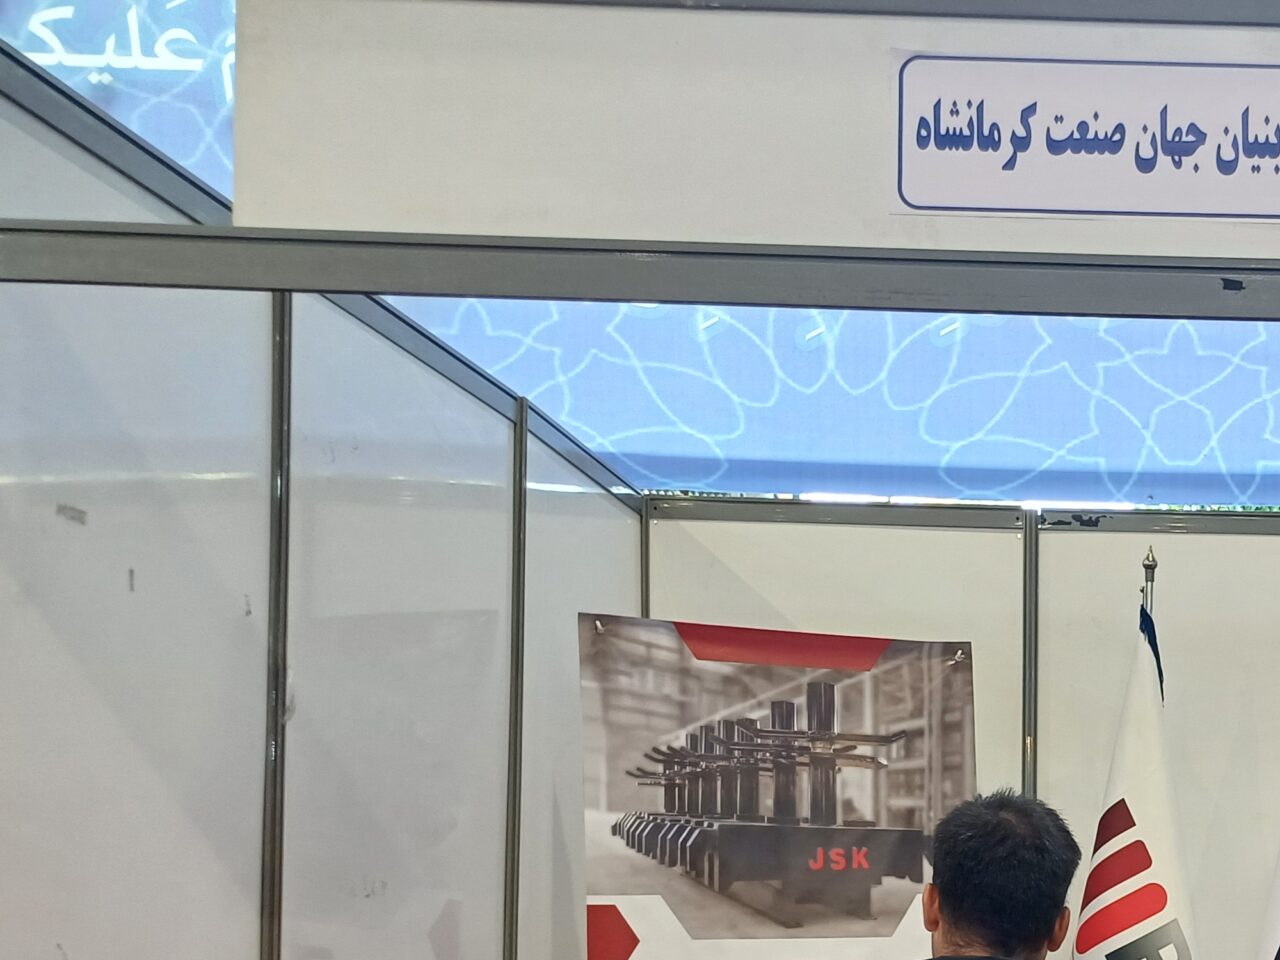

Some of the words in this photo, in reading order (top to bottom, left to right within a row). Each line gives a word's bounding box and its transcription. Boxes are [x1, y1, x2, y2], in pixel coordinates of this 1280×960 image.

[916, 98, 1038, 171] کرمانشاه
[1045, 110, 1127, 157] صنعت
[1134, 103, 1207, 175] جهان
[808, 847, 871, 872] JSK
